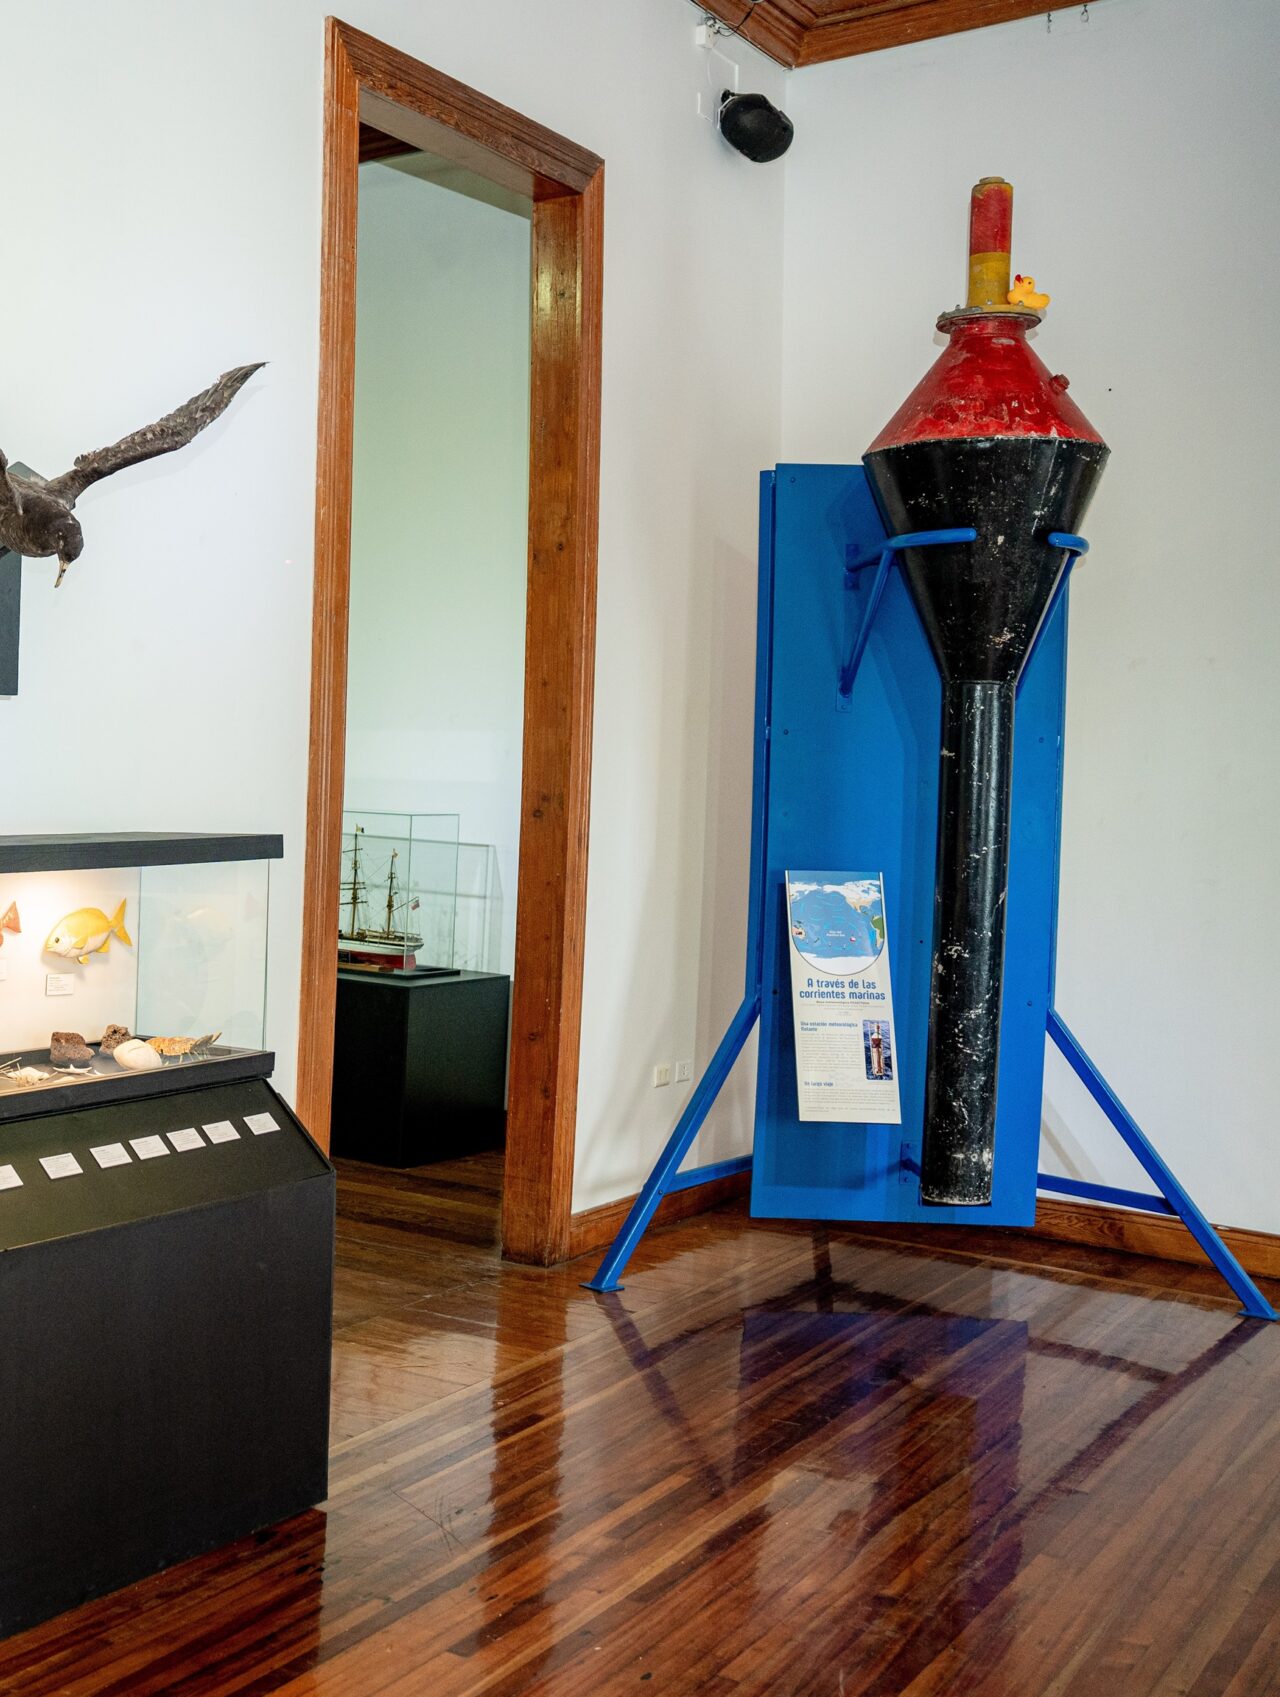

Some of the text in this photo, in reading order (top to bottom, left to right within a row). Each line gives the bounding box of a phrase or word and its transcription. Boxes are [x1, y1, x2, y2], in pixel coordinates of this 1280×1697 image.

[807, 978, 876, 989] A través de las
[799, 989, 886, 1000] corrientes marinas
